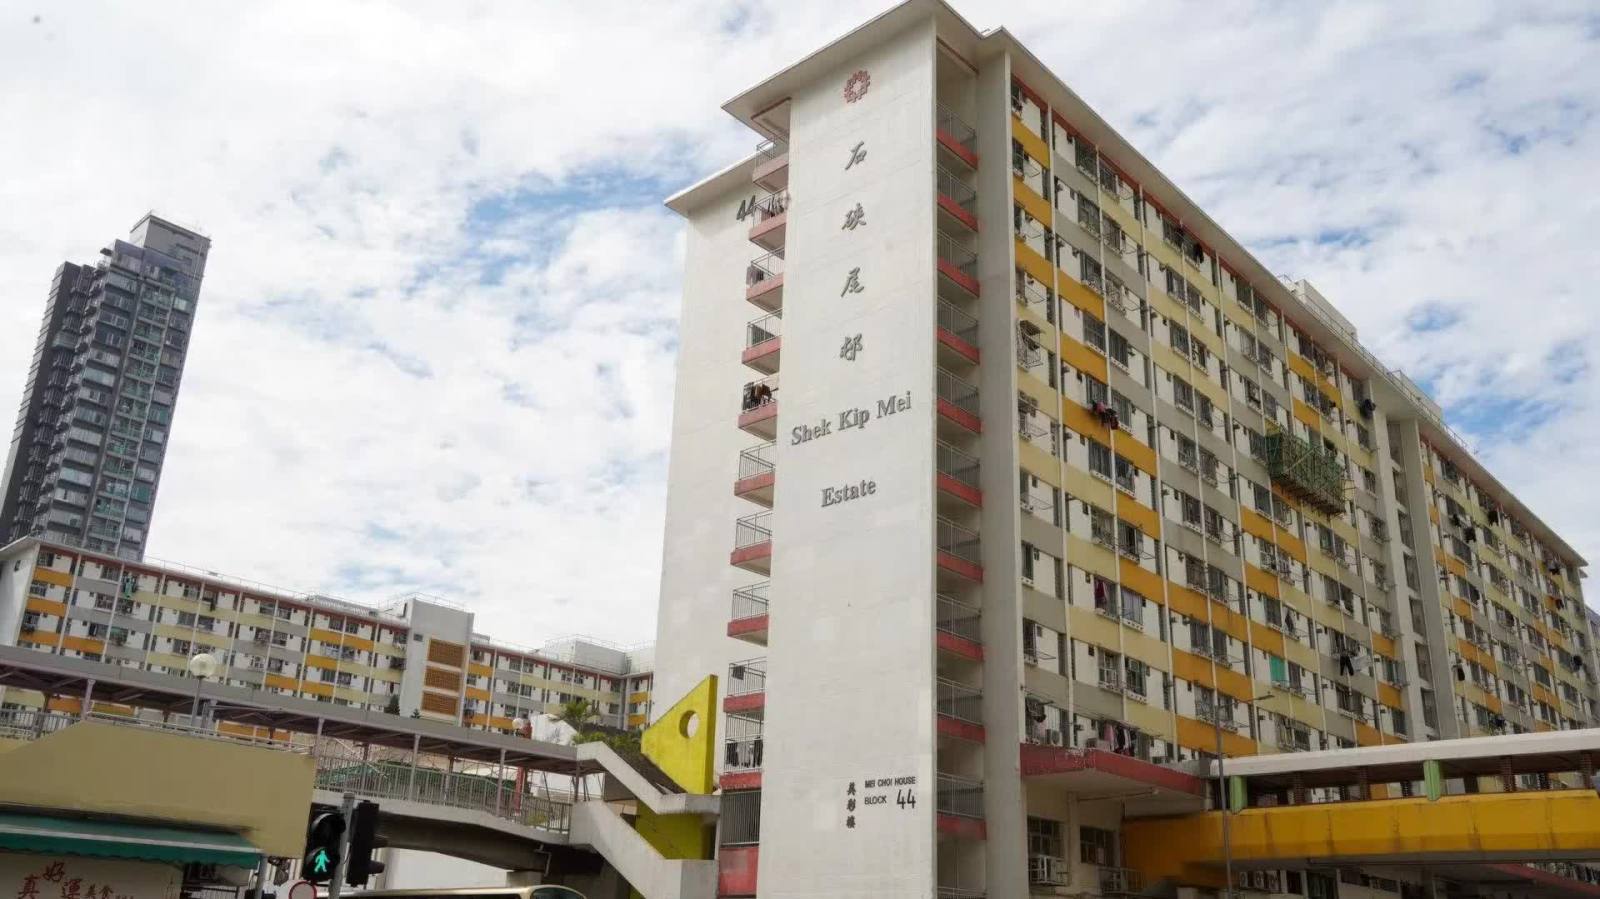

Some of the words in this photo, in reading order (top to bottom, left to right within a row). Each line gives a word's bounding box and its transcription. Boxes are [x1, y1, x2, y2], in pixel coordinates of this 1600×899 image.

[736, 195, 756, 222] 44
[791, 419, 832, 446] Shek
[838, 407, 870, 431] Kip
[876, 391, 912, 419] Mei
[821, 479, 877, 508] Estate
[865, 779, 875, 788] MEI
[877, 778, 893, 787] CHOI
[895, 776, 916, 785] HOUSE
[864, 795, 887, 805] BLOCK
[896, 788, 917, 810] 44
